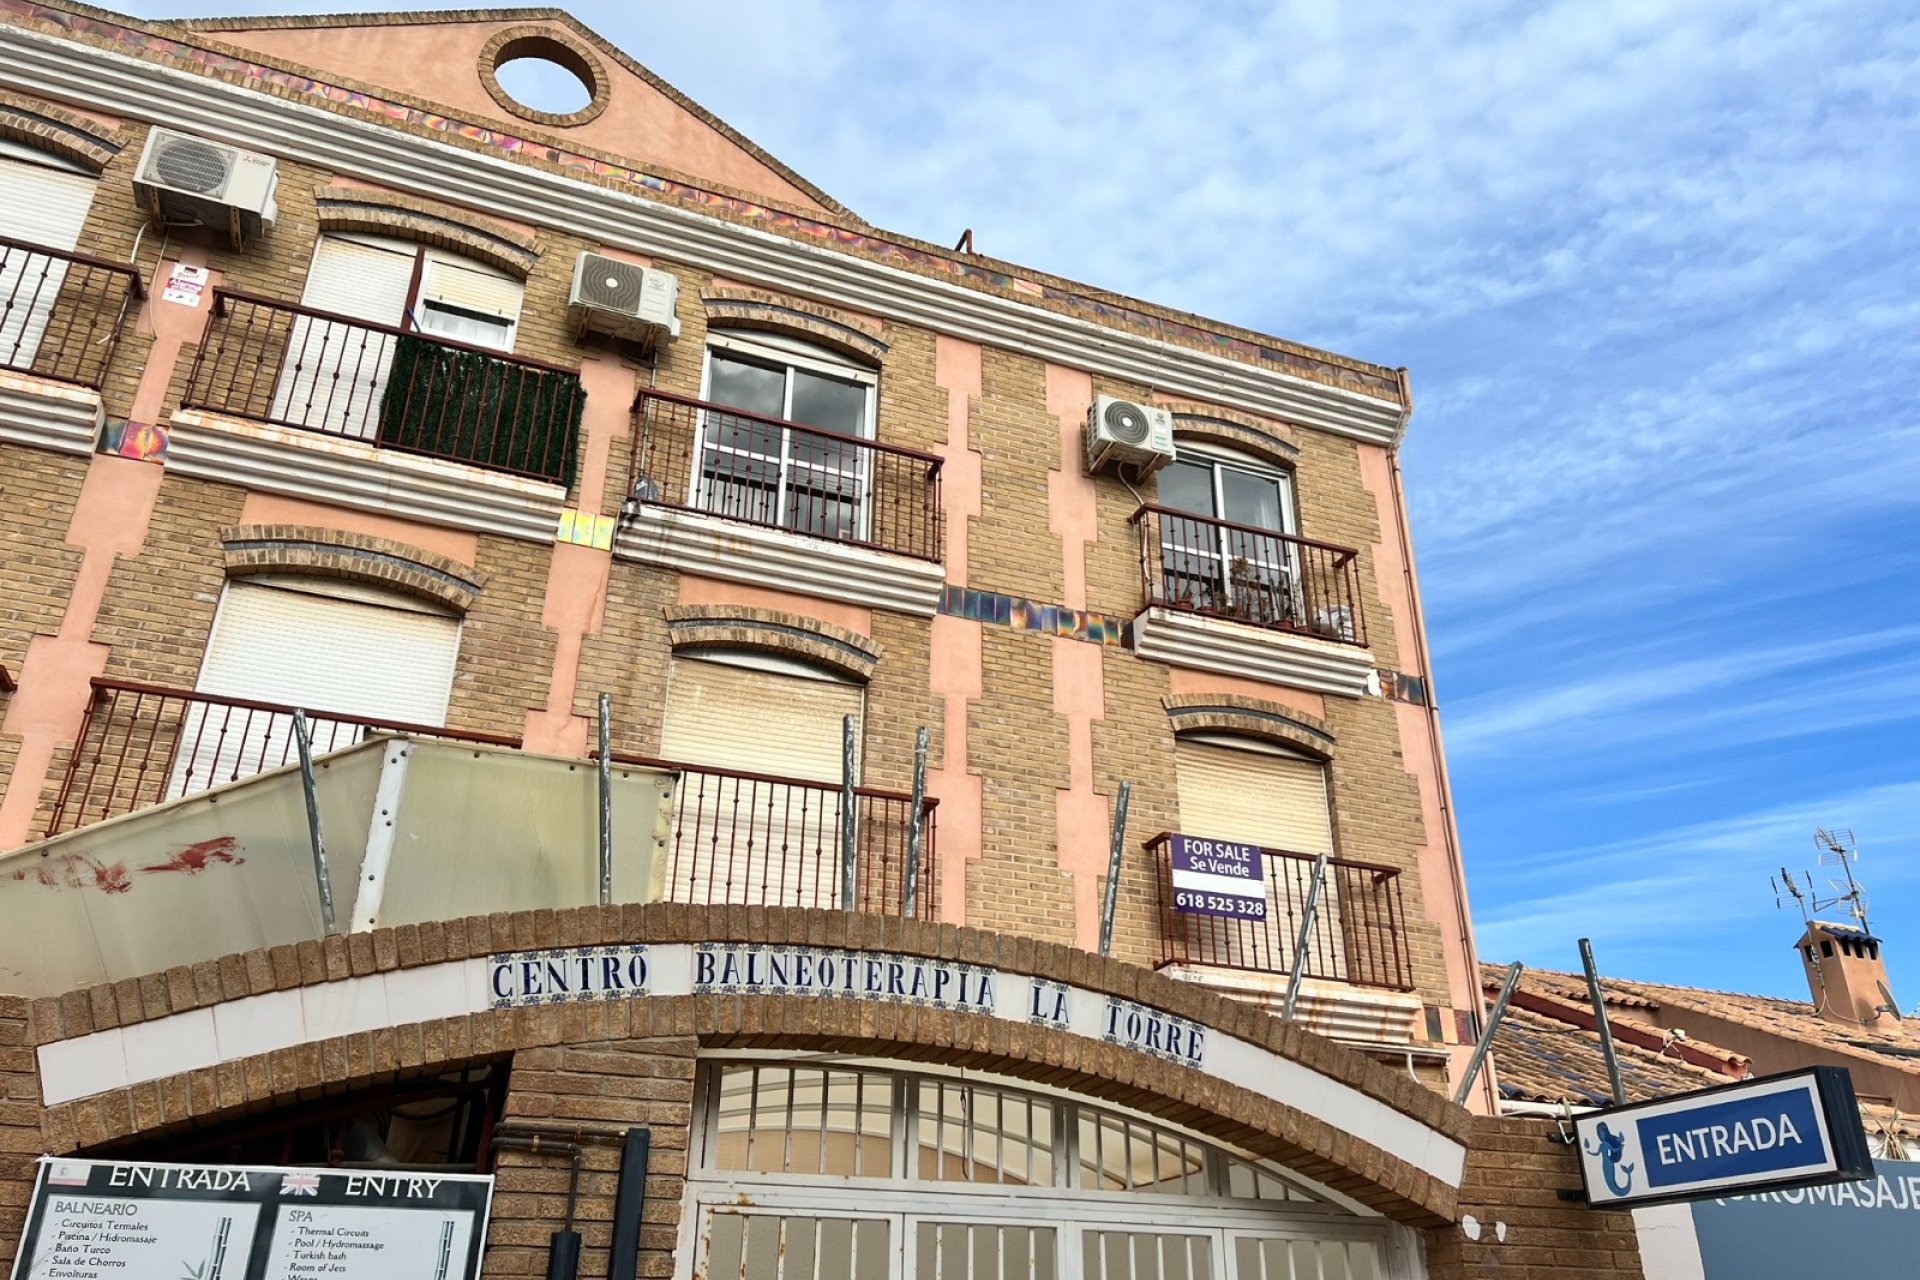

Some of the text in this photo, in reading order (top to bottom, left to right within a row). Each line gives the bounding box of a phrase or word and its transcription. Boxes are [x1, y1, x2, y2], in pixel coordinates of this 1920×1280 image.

[1184, 839, 1251, 862] FOR SALE
[1190, 856, 1250, 877] Se Vende
[1176, 892, 1264, 916] 618 525 328
[492, 952, 1205, 1061] CENTRO BALNEOTERAPIA LA TORRE
[1655, 1113, 1802, 1166] ENTRADA
[109, 1165, 441, 1198] ENTRADA ENTRY
[1714, 1175, 1920, 1210] MASAJE
[54, 1201, 138, 1216] BALNEARIO
[288, 1210, 313, 1222] SPA
[61, 1219, 149, 1231] Circuitos Termales
[297, 1226, 369, 1237] Thermal Circuits
[58, 1231, 90, 1241] Piscina
[99, 1232, 158, 1245] Hidromasaje
[294, 1238, 315, 1248] Pool
[322, 1239, 384, 1251] Hydromassage
[55, 1243, 111, 1254] Baño Turco
[292, 1250, 347, 1260] Turkish bath
[52, 1255, 126, 1267] Sala de Chorros
[289, 1262, 346, 1272] Room of Jets
[48, 1268, 98, 1279] Envolturas
